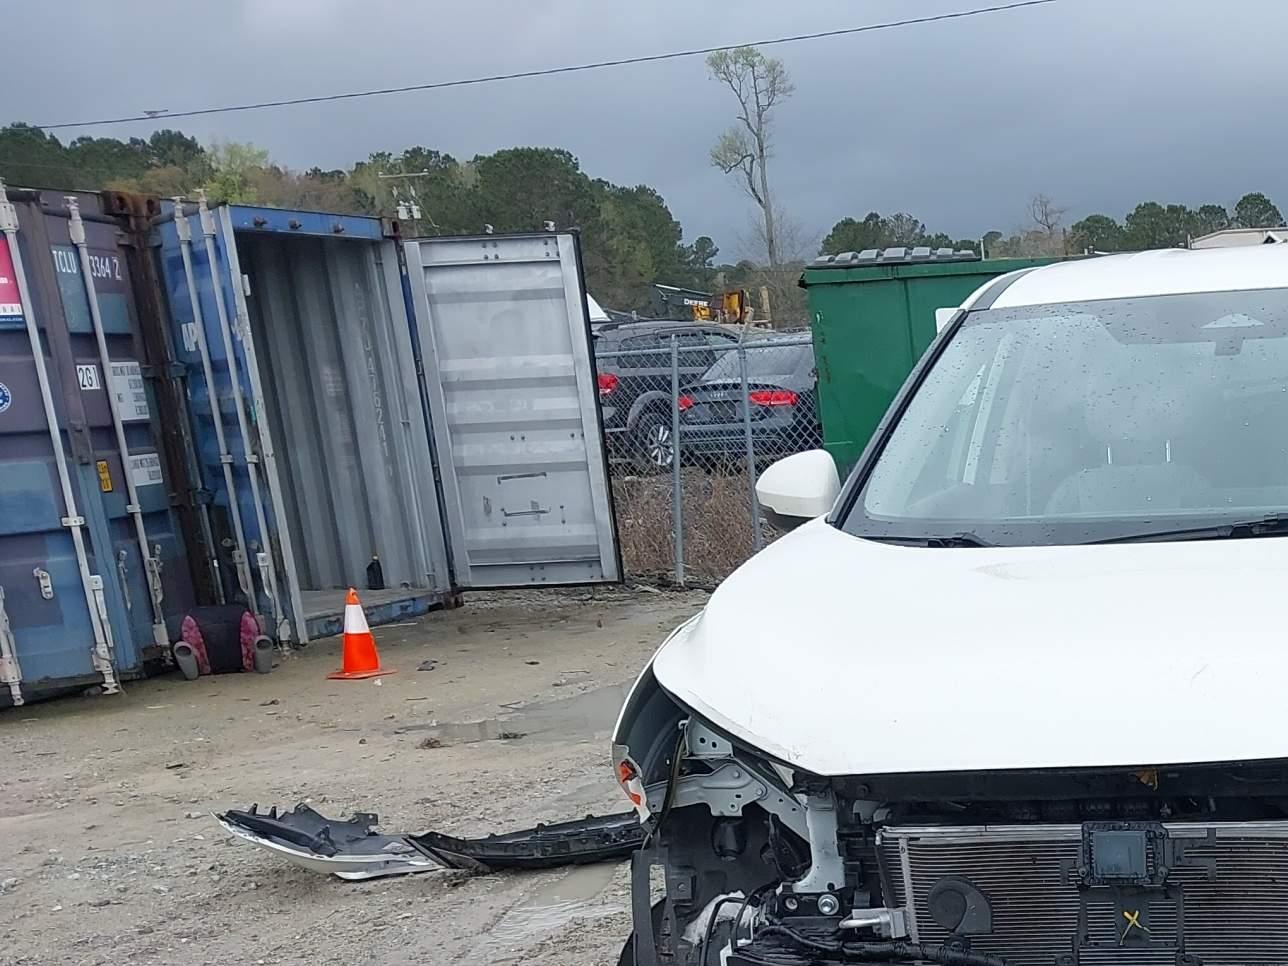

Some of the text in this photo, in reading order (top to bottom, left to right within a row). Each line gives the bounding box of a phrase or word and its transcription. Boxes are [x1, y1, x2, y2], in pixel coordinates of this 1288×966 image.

[52, 250, 77, 274] TCLU
[89, 255, 111, 279] 3364
[181, 322, 199, 352] AP
